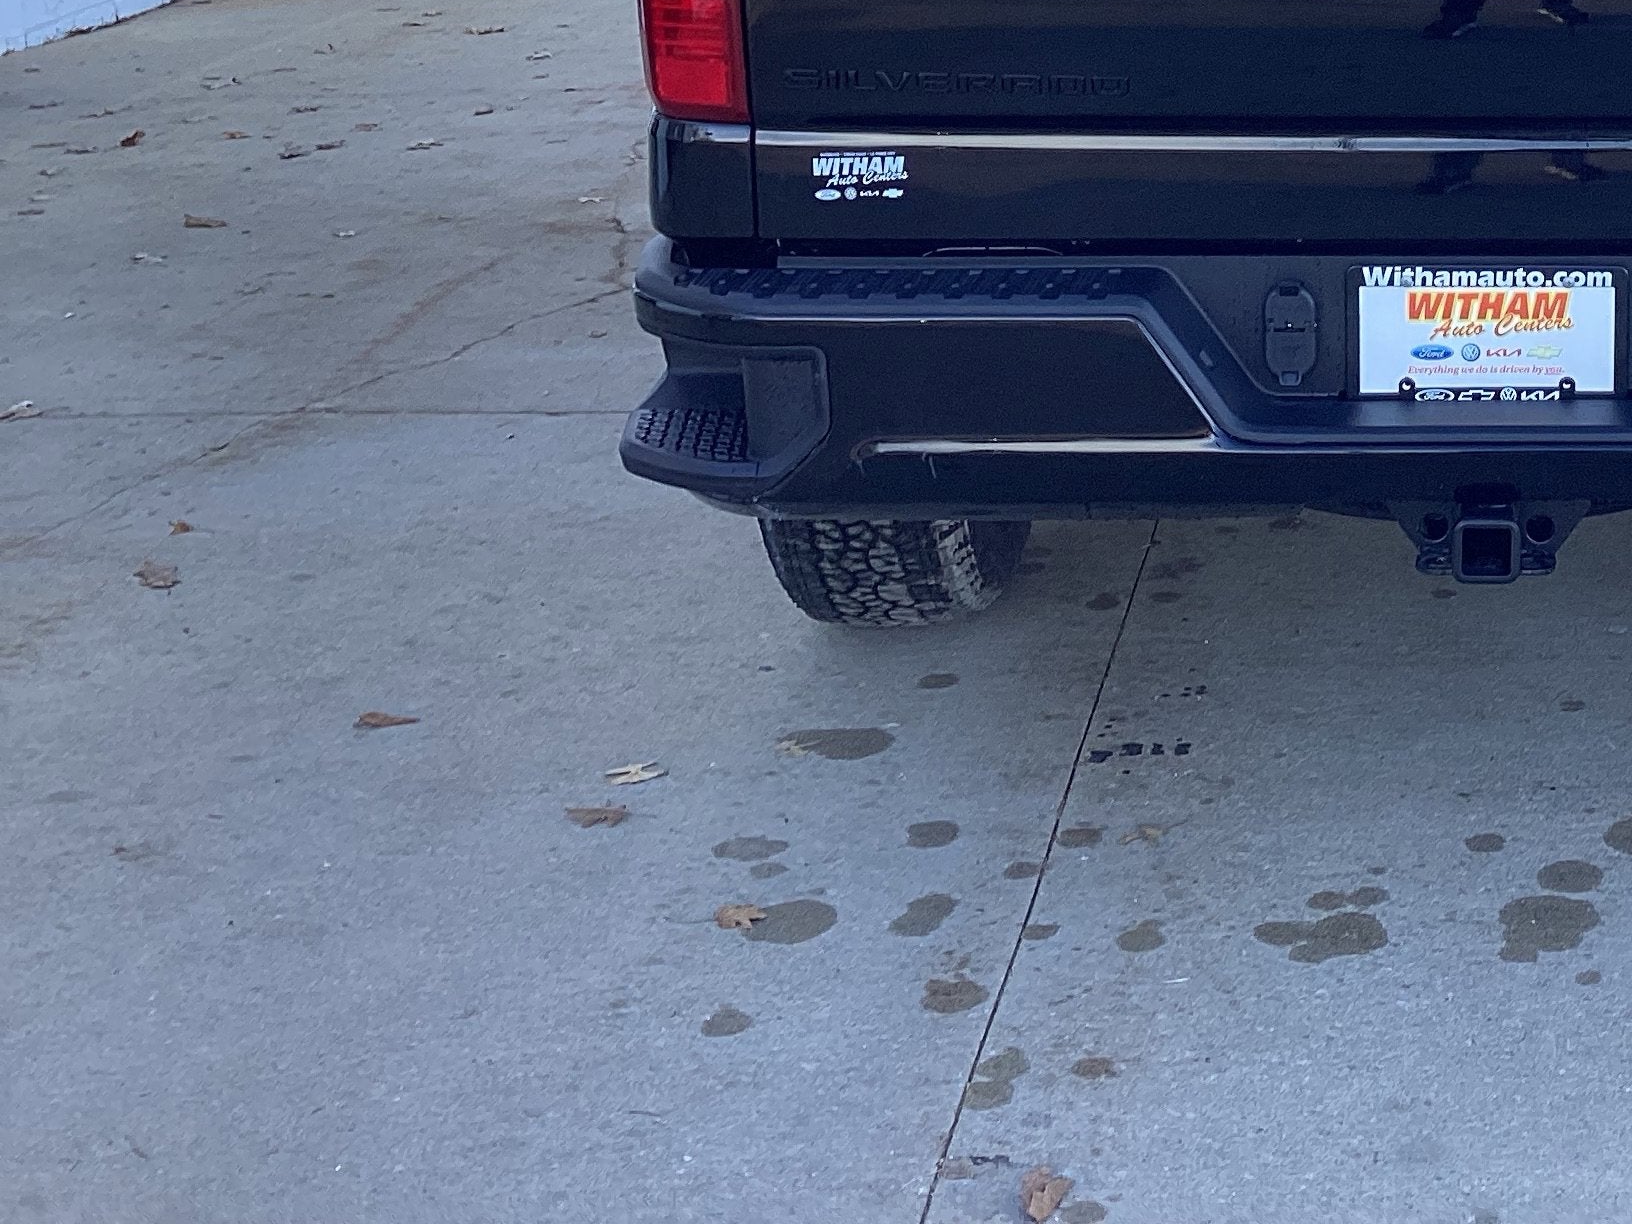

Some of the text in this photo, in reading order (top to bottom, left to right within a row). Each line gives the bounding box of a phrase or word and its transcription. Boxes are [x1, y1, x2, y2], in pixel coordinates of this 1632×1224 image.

[783, 67, 1131, 97] SILVERADO
[812, 156, 905, 176] WITHAM
[826, 170, 909, 187] Auto Centers
[1362, 266, 1613, 287] Withamauto.com
[1407, 290, 1570, 321] WITHAM
[1429, 313, 1574, 340] Auto Centers
[1408, 365, 1459, 375] Everything
[1476, 365, 1488, 374] do
[1490, 365, 1498, 374] is
[1499, 364, 1530, 374] driven
[1532, 364, 1543, 375] by
